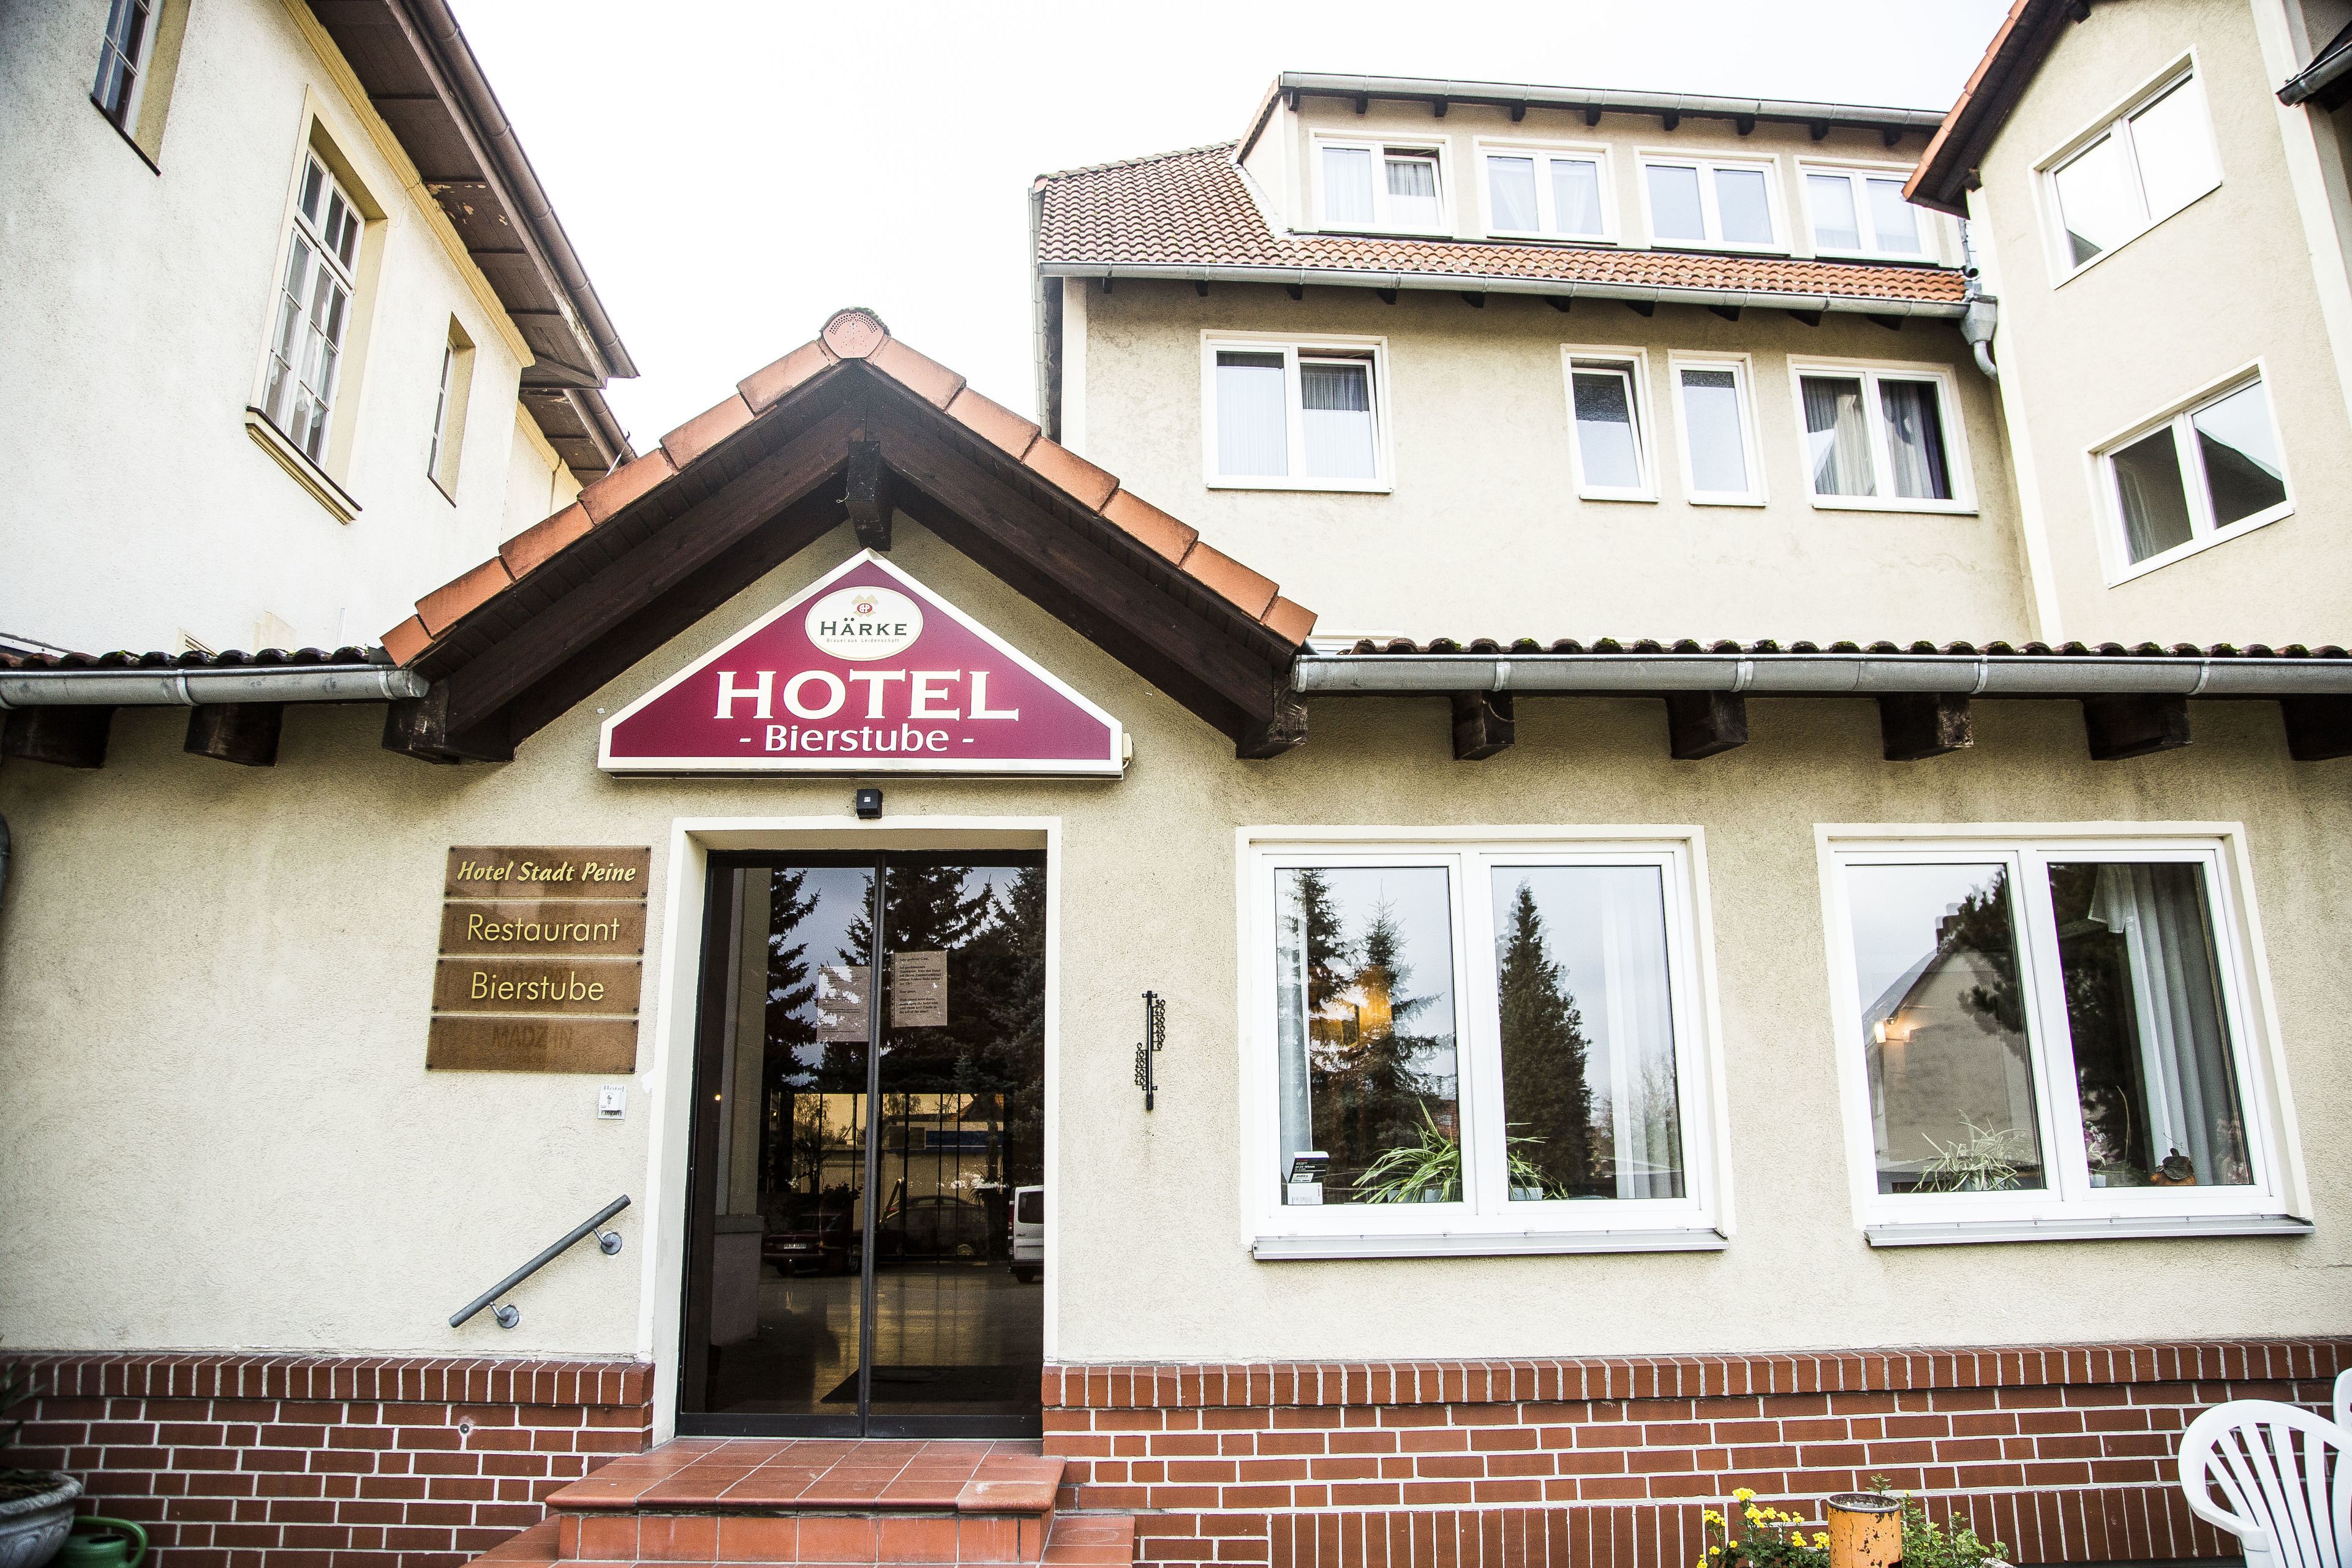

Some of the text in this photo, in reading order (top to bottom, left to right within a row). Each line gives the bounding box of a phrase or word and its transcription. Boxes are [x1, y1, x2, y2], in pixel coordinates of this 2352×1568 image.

[820, 617, 907, 636] HÄRKE
[713, 668, 1019, 722] HOTEL
[765, 723, 949, 752] Bierstube
[457, 861, 636, 881] Hotel Stadt Peine
[467, 914, 620, 941] Restaurant
[471, 971, 604, 1000] Bierstube
